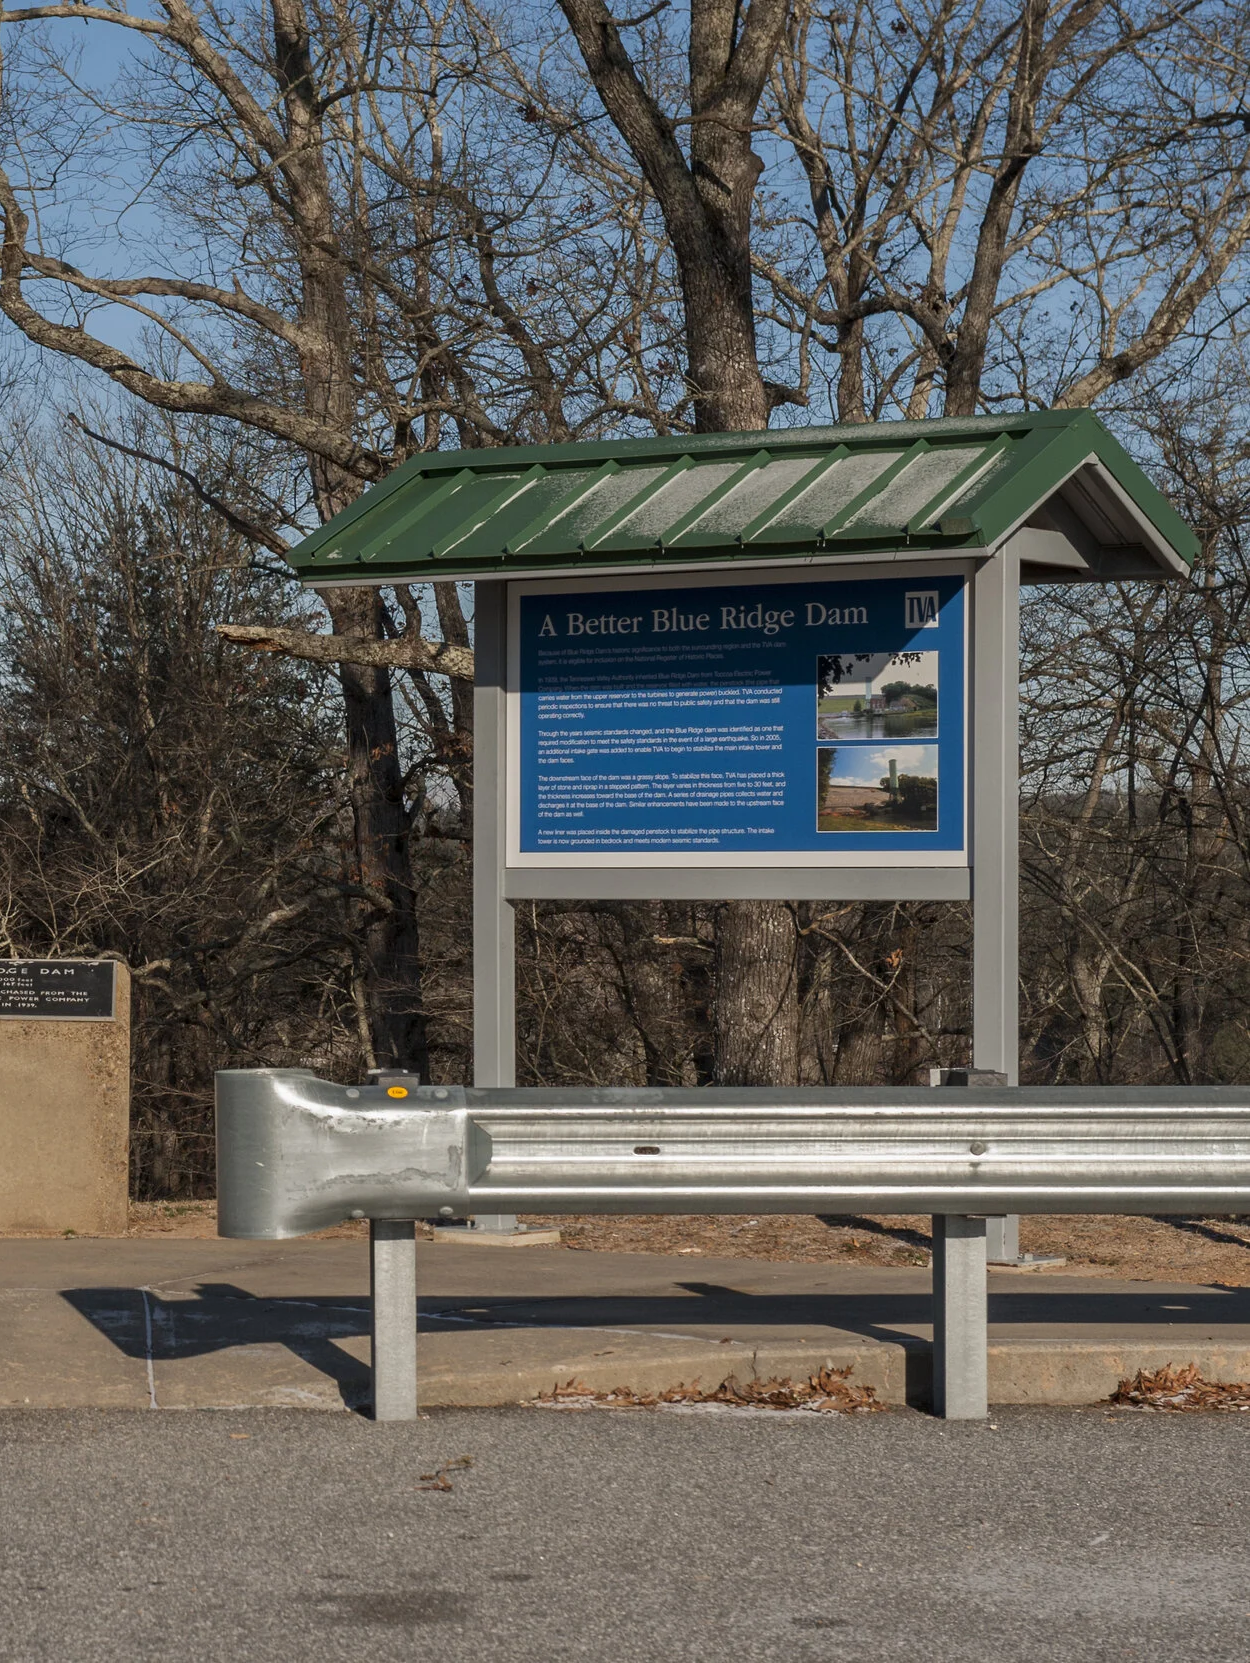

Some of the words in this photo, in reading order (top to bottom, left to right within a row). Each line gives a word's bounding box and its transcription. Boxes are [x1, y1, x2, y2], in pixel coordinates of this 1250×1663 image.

[538, 614, 558, 636] A
[566, 612, 643, 636] Better
[651, 607, 710, 632] Blue
[720, 602, 795, 635] Ridge
[805, 602, 869, 626] Dam
[906, 596, 937, 623] TVA
